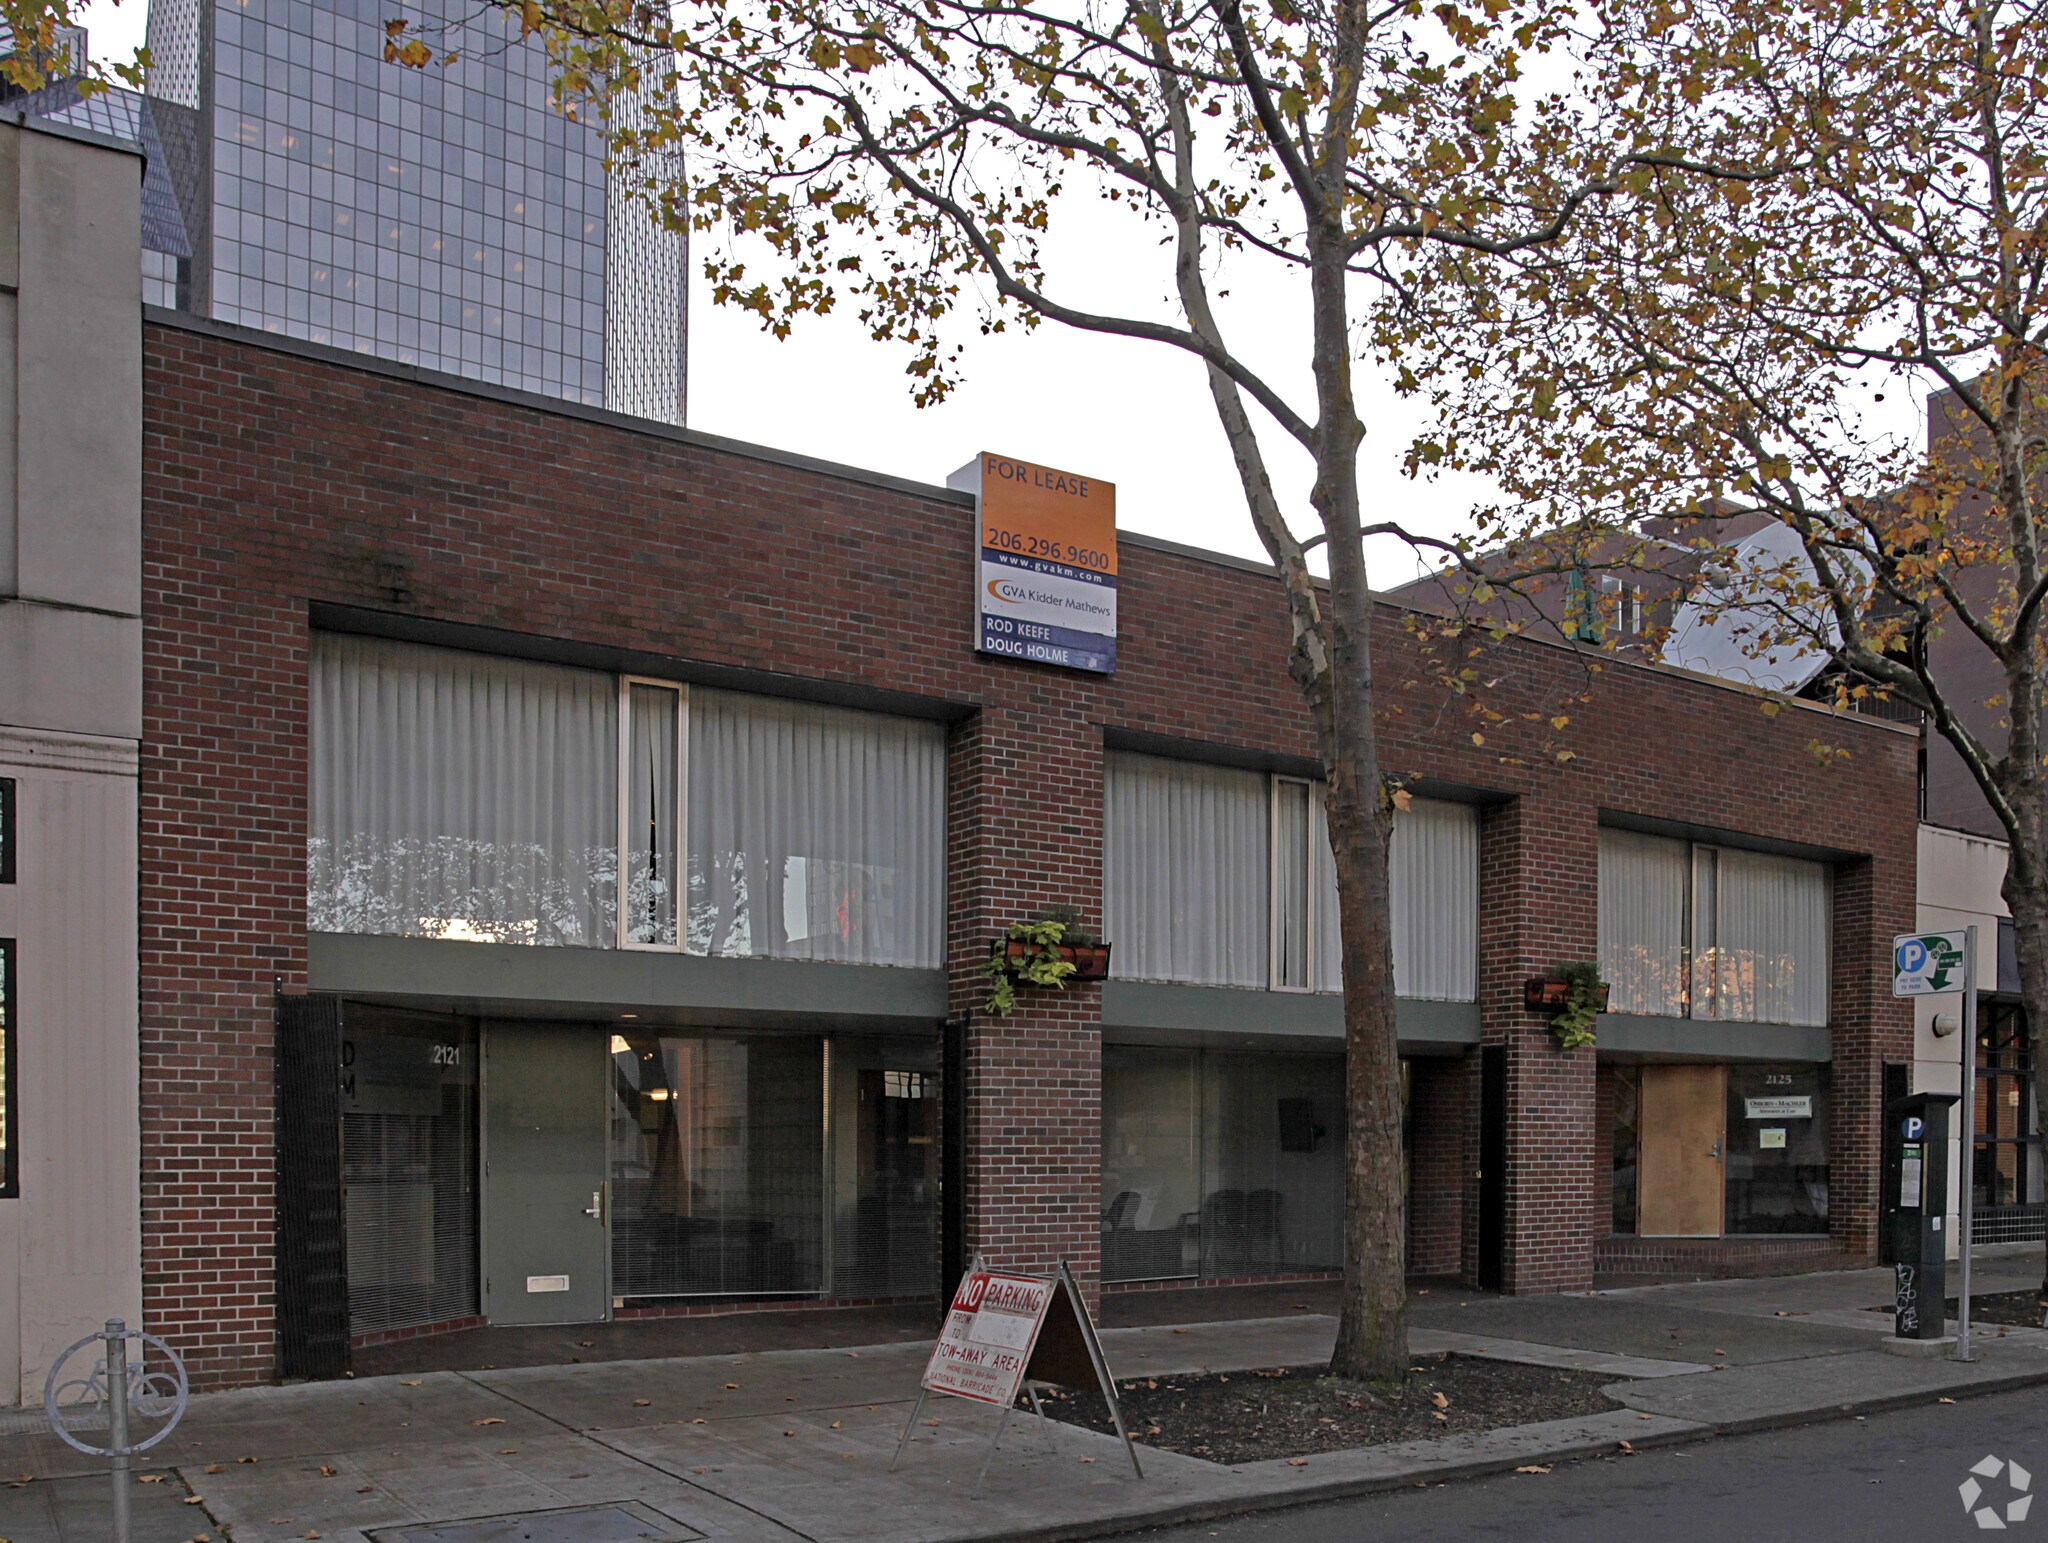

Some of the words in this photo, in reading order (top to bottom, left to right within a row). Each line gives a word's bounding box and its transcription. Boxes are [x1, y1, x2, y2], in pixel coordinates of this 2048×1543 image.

[987, 458, 1028, 484] FOR
[1034, 469, 1089, 498] LEASE
[988, 528, 1109, 570] 206.296.9600
[999, 554, 1103, 583] www.gvakm.com
[1002, 584, 1026, 600] GVA
[1028, 590, 1063, 607] Kidder
[1065, 597, 1111, 617] Mathews
[986, 617, 1013, 633] ROD
[1017, 624, 1050, 641] KEEFE
[986, 636, 1022, 655] DOUG
[1027, 646, 1068, 663] HOLME
[1905, 945, 1922, 969] P
[433, 1044, 460, 1065] 2121
[1765, 1074, 1792, 1084] 2125
[1908, 1117, 1922, 1138] P
[957, 1279, 984, 1307] NO
[984, 1283, 1044, 1312] PARKING
[953, 1312, 972, 1325] FROM
[952, 1328, 961, 1339] TO
[937, 1342, 988, 1365] TOW-AWAY
[991, 1355, 1019, 1374] AREA
[930, 1371, 957, 1386] NATIONAL
[959, 1378, 994, 1395] BARRICADE
